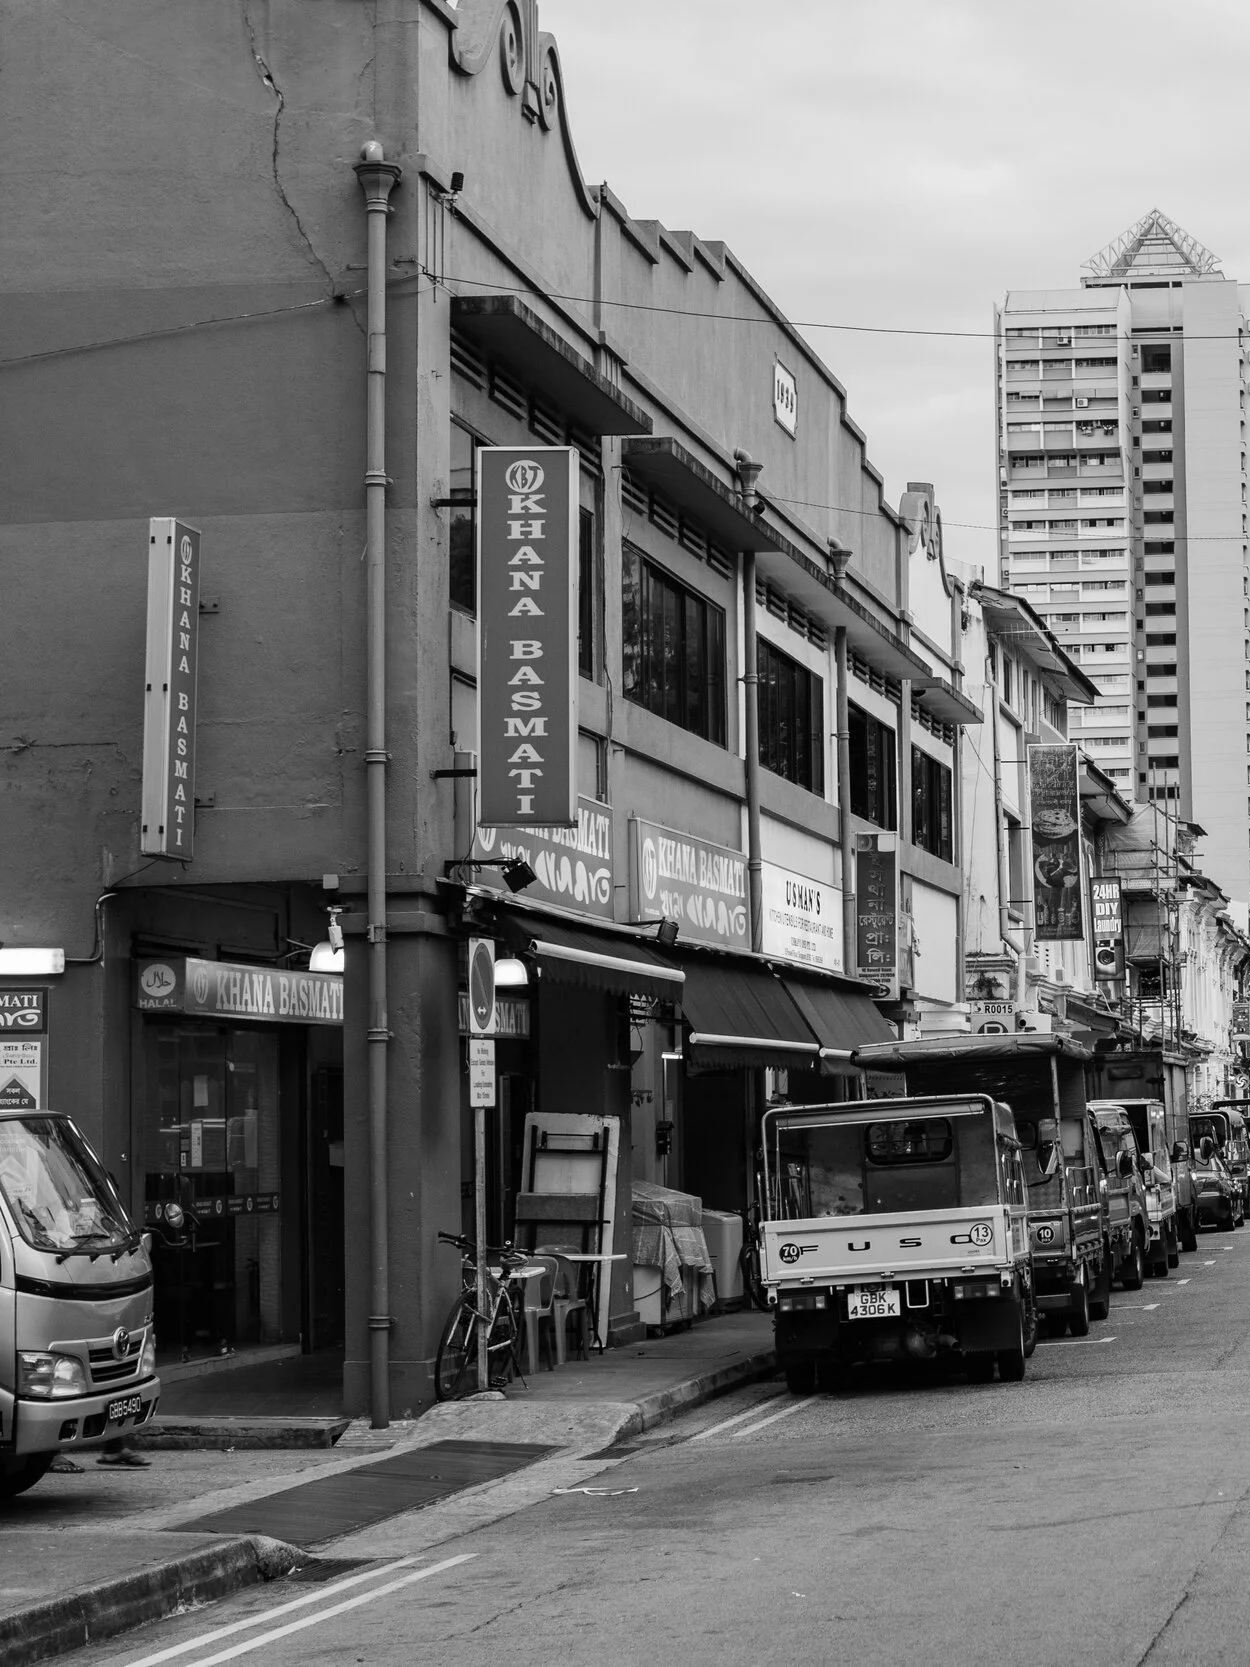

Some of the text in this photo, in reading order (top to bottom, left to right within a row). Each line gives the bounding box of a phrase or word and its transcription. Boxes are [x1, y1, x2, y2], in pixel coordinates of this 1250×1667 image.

[507, 493, 546, 617] KHANA
[179, 563, 193, 674] KHANA
[503, 640, 549, 815] BASMATI
[174, 692, 190, 847] BASMATI
[658, 837, 745, 898] KHANA BASMATI
[785, 880, 821, 915] USMAN'S
[1093, 884, 1119, 899] 24HR
[1095, 902, 1118, 915] DIY
[216, 971, 344, 1019] KHANA BASMATI
[139, 999, 177, 1008] HALAL
[984, 1005, 1013, 1014] R0015
[974, 1227, 989, 1238] 13
[1039, 1229, 1052, 1238] 10
[782, 1246, 798, 1256] 70
[860, 1292, 887, 1304] GBK
[850, 1302, 896, 1316] 4306K
